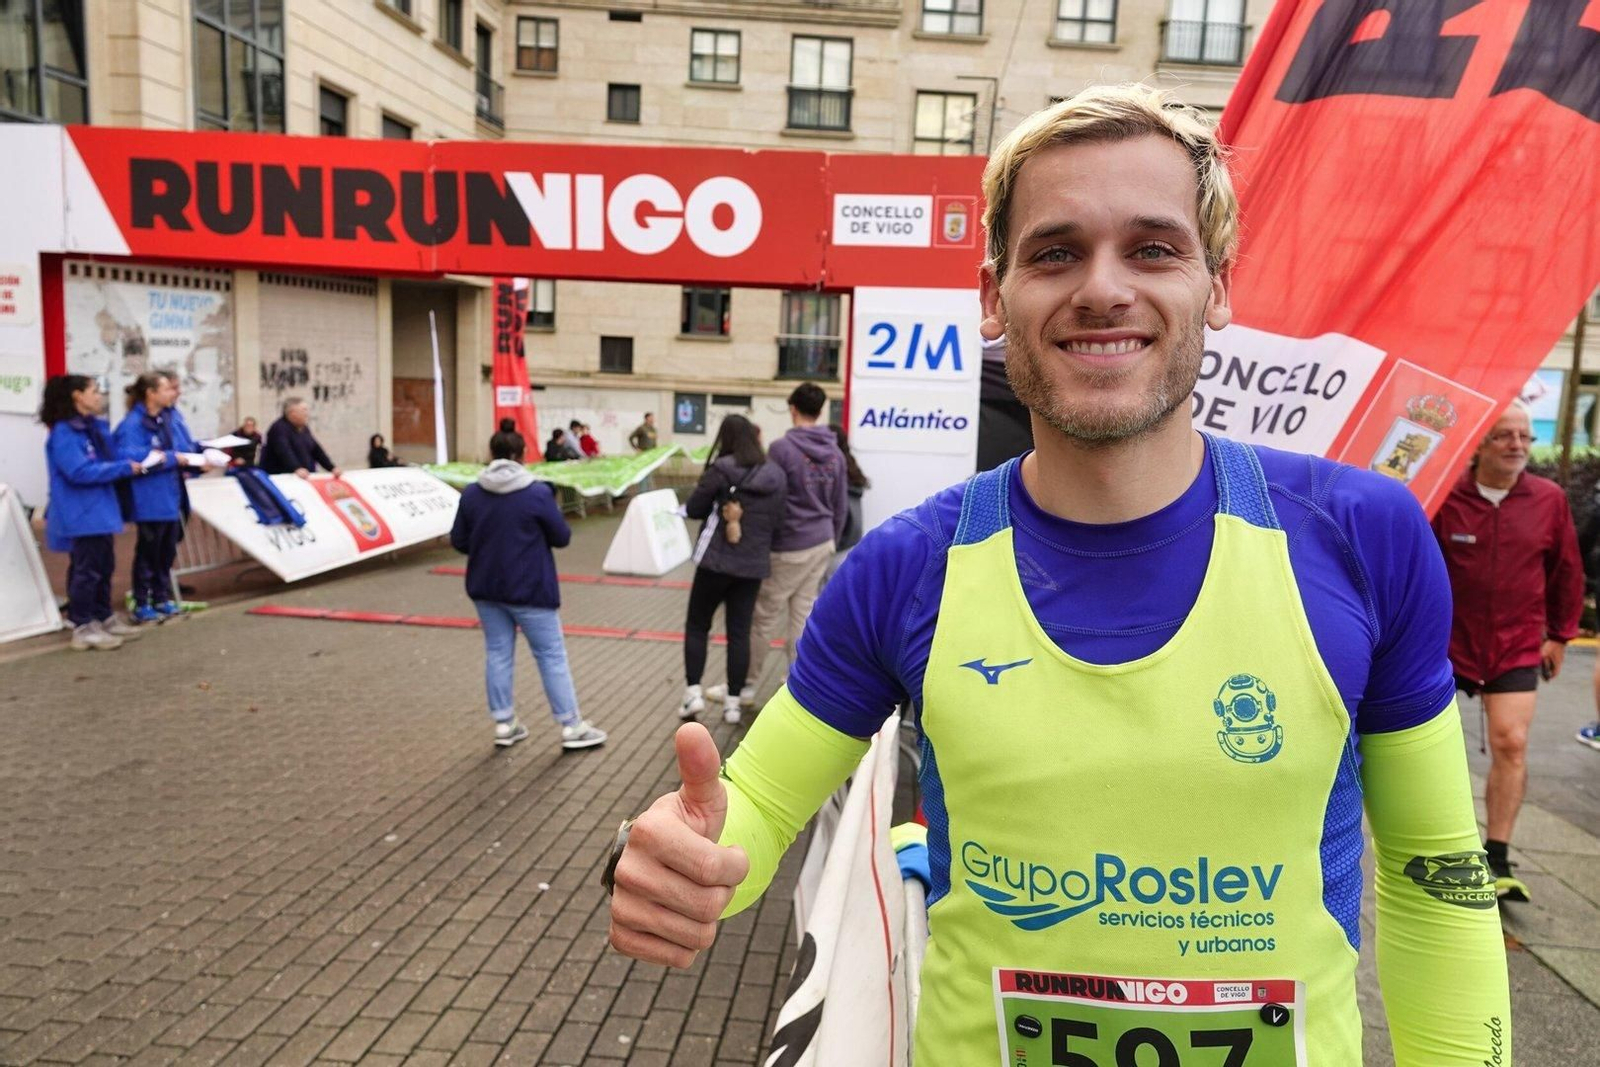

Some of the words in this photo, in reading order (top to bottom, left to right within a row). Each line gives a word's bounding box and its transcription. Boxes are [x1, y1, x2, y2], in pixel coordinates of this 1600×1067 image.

[841, 205, 924, 219] CONCELLO
[850, 221, 870, 234] DE
[876, 221, 914, 235] VIGO
[1199, 350, 1347, 401] ONCELO
[859, 407, 969, 430] Atlántico
[1098, 911, 1184, 929] servicios
[1190, 910, 1275, 929] técnicos
[1178, 939, 1190, 956] y
[1196, 936, 1276, 954] urbanos
